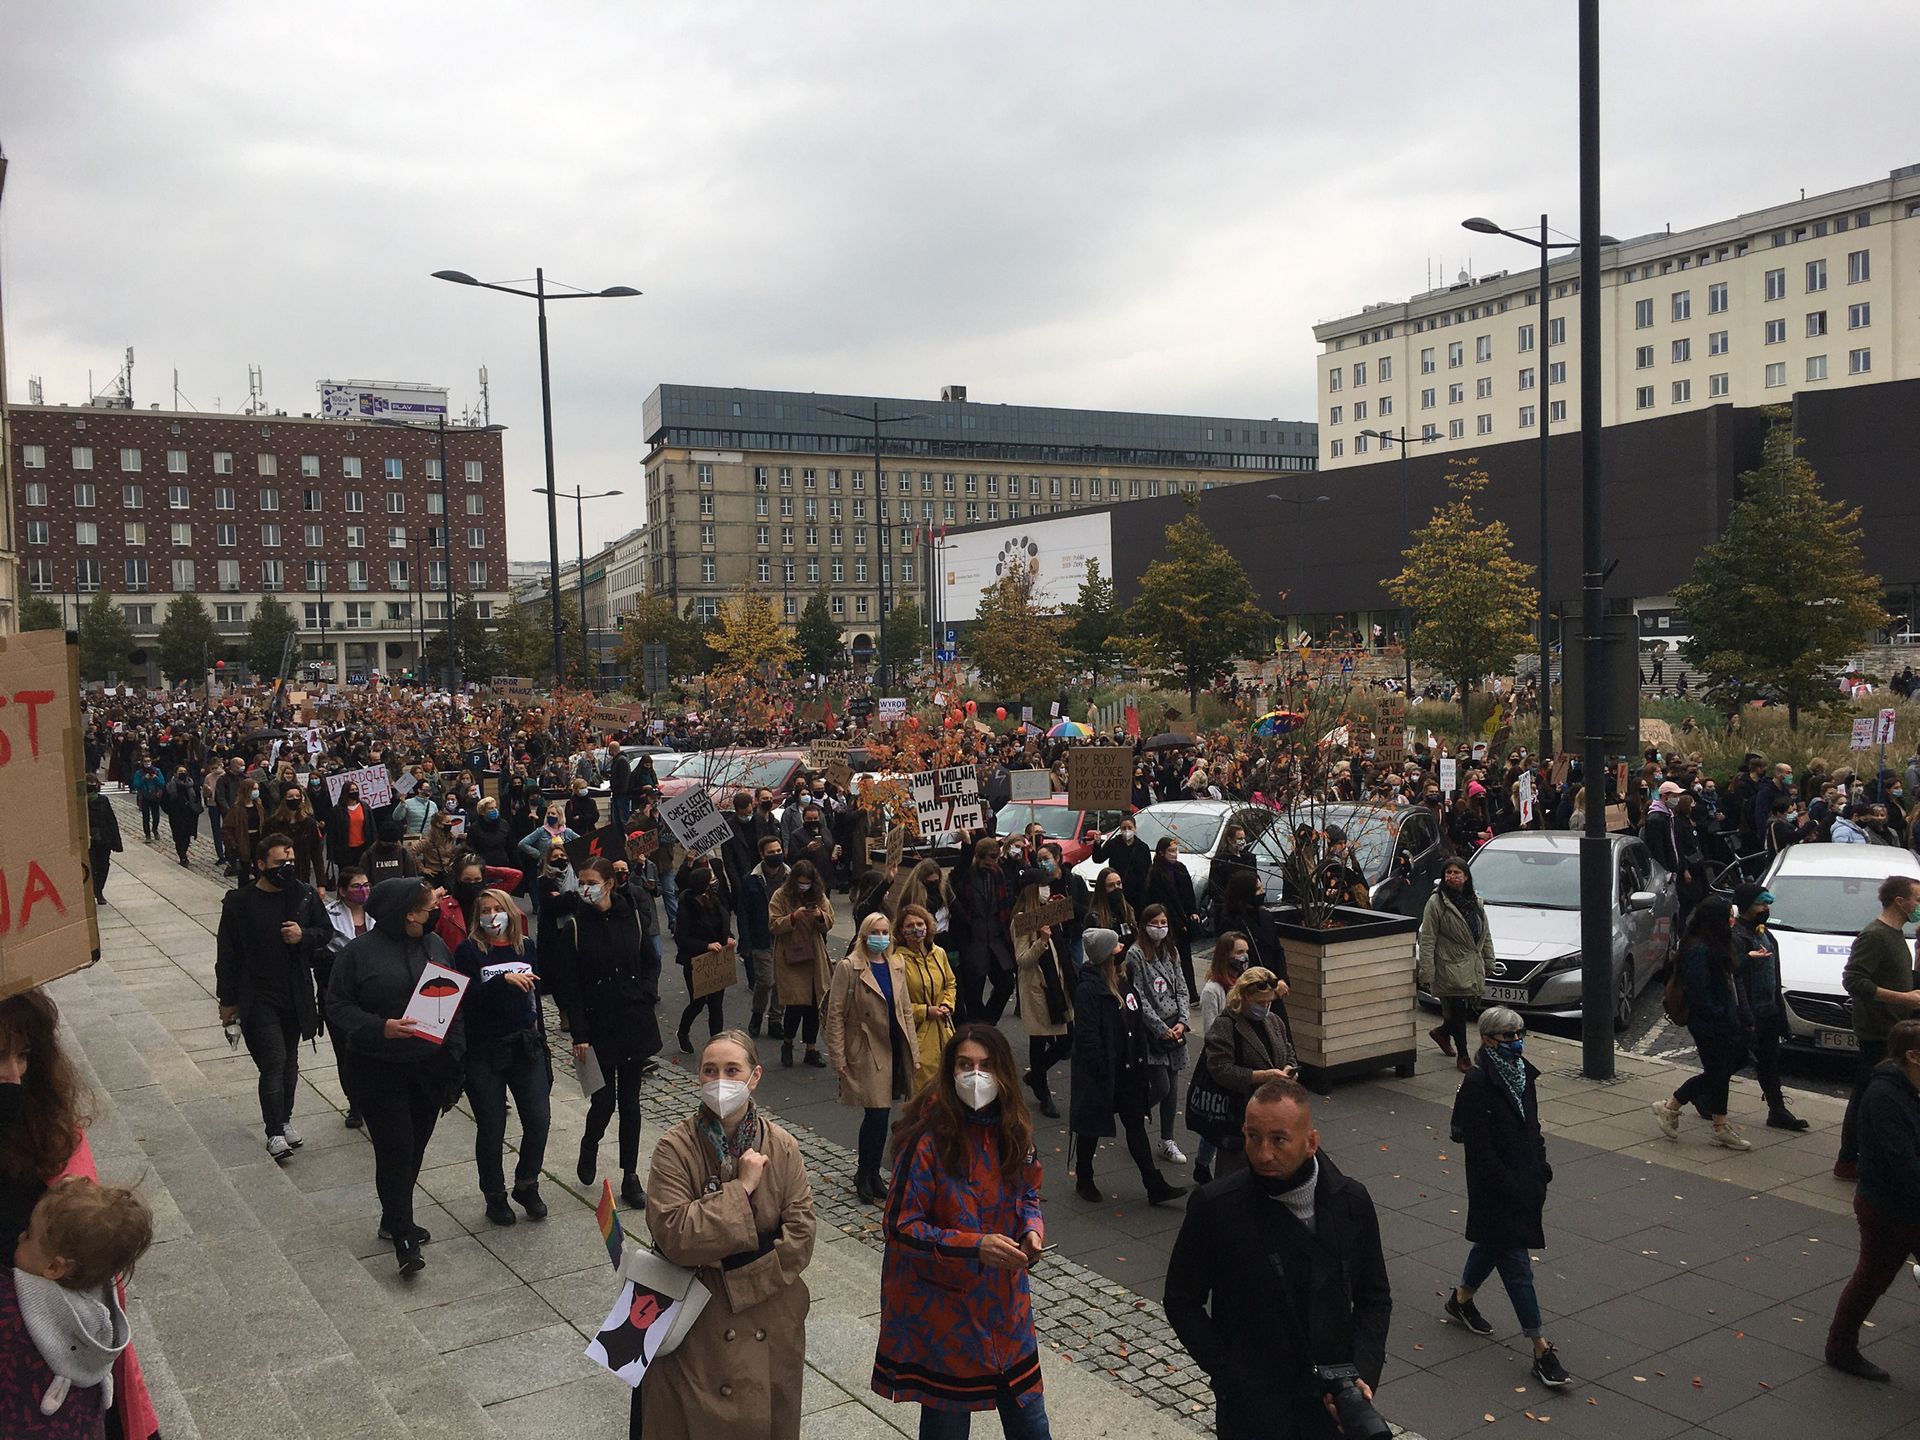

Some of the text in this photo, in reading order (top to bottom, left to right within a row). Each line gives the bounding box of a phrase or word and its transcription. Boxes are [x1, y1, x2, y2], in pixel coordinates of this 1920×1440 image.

[948, 630, 954, 639] P
[491, 687, 504, 696] NIE
[880, 700, 905, 708] WYROK
[1378, 737, 1389, 746] BE
[473, 756, 480, 764] P
[1075, 753, 1117, 765] MY BODY
[1378, 749, 1402, 762] SHIT
[1075, 766, 1123, 777] MY CHOICE
[914, 772, 935, 788] MAM
[1075, 779, 1130, 790] MY COUNTRY
[1075, 790, 1121, 801] MY VOICE
[919, 797, 943, 814] MAM
[921, 812, 978, 834] PIS OFF
[1490, 987, 1526, 1001] 218JX
[1824, 1032, 1842, 1046] FG
